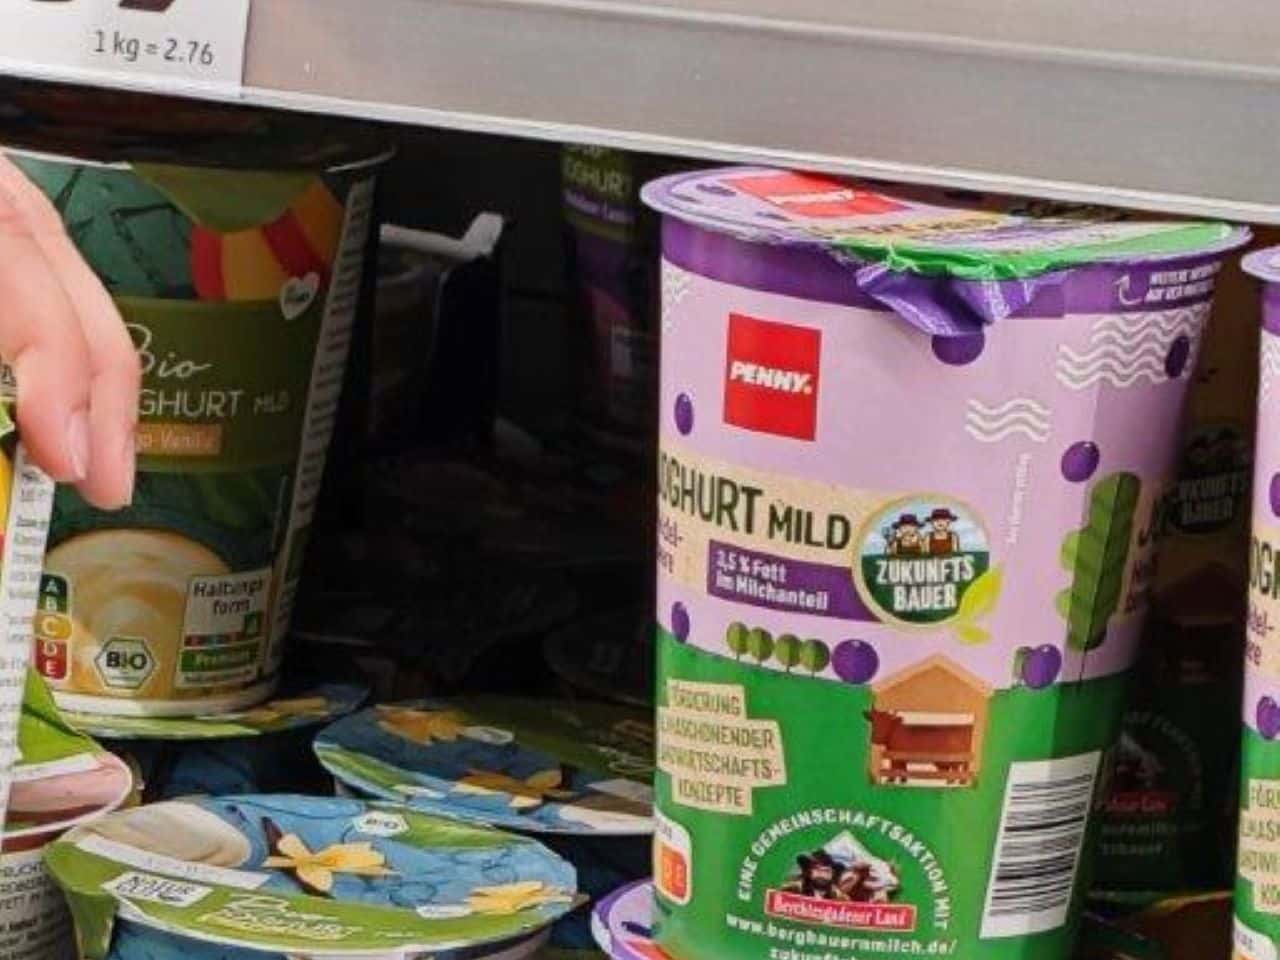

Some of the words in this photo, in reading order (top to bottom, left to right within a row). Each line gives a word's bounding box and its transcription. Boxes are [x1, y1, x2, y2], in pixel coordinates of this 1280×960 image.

[94, 29, 105, 53] 1
[114, 31, 140, 61] kg
[164, 38, 213, 66] 2.76
[730, 361, 812, 394] PENNY.
[137, 389, 244, 418] GHURT
[769, 504, 850, 550] MILD
[875, 556, 975, 584] ZUKUNFTS
[735, 576, 828, 611] Milchanteil
[893, 585, 955, 612] BAUER
[738, 856, 757, 901] EINE
[751, 808, 948, 894] GEMEINSCHAFTSAKTION
[935, 898, 951, 930] MIT
